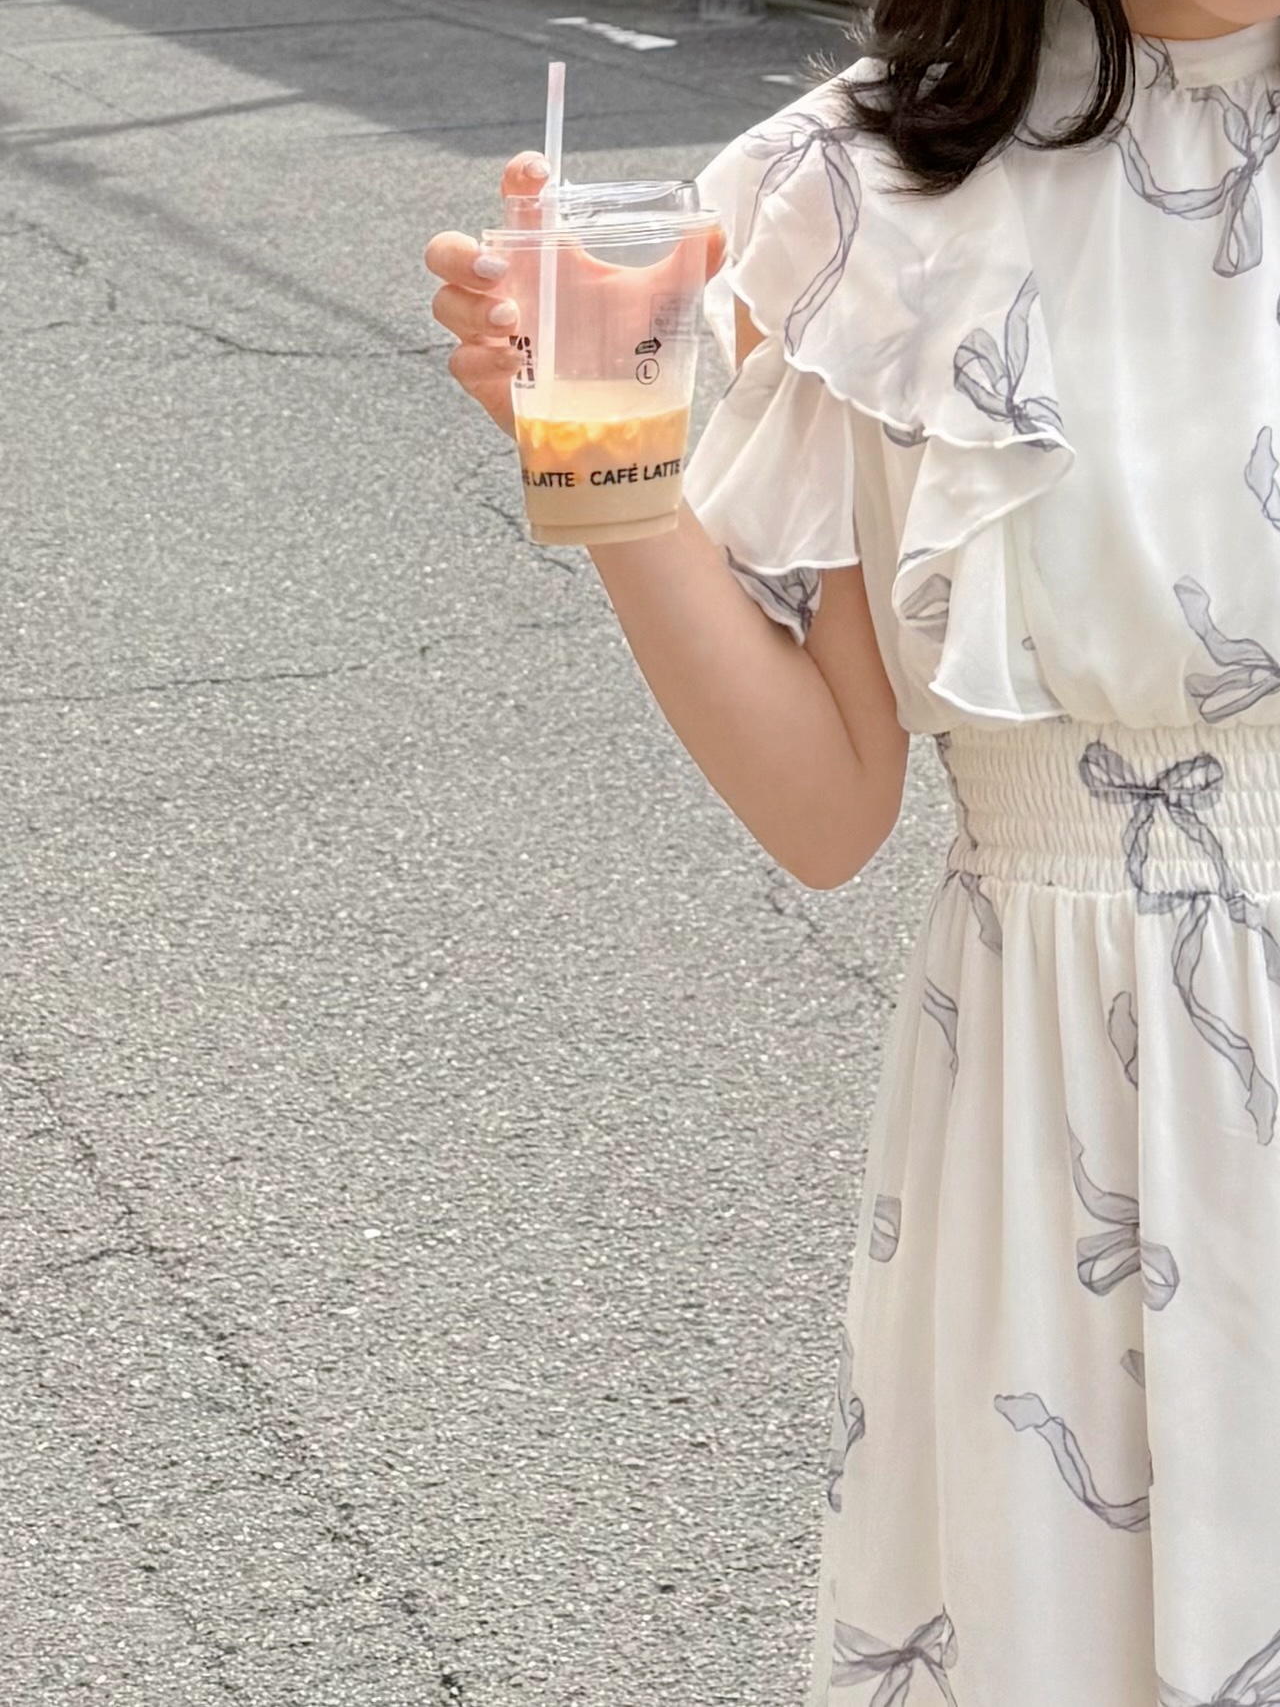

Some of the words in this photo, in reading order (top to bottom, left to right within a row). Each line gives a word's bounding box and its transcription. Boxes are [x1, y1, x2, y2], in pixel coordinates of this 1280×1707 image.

[531, 470, 576, 488] LATTE
[589, 462, 639, 487] CAFÉ
[643, 457, 681, 481] LATTE
